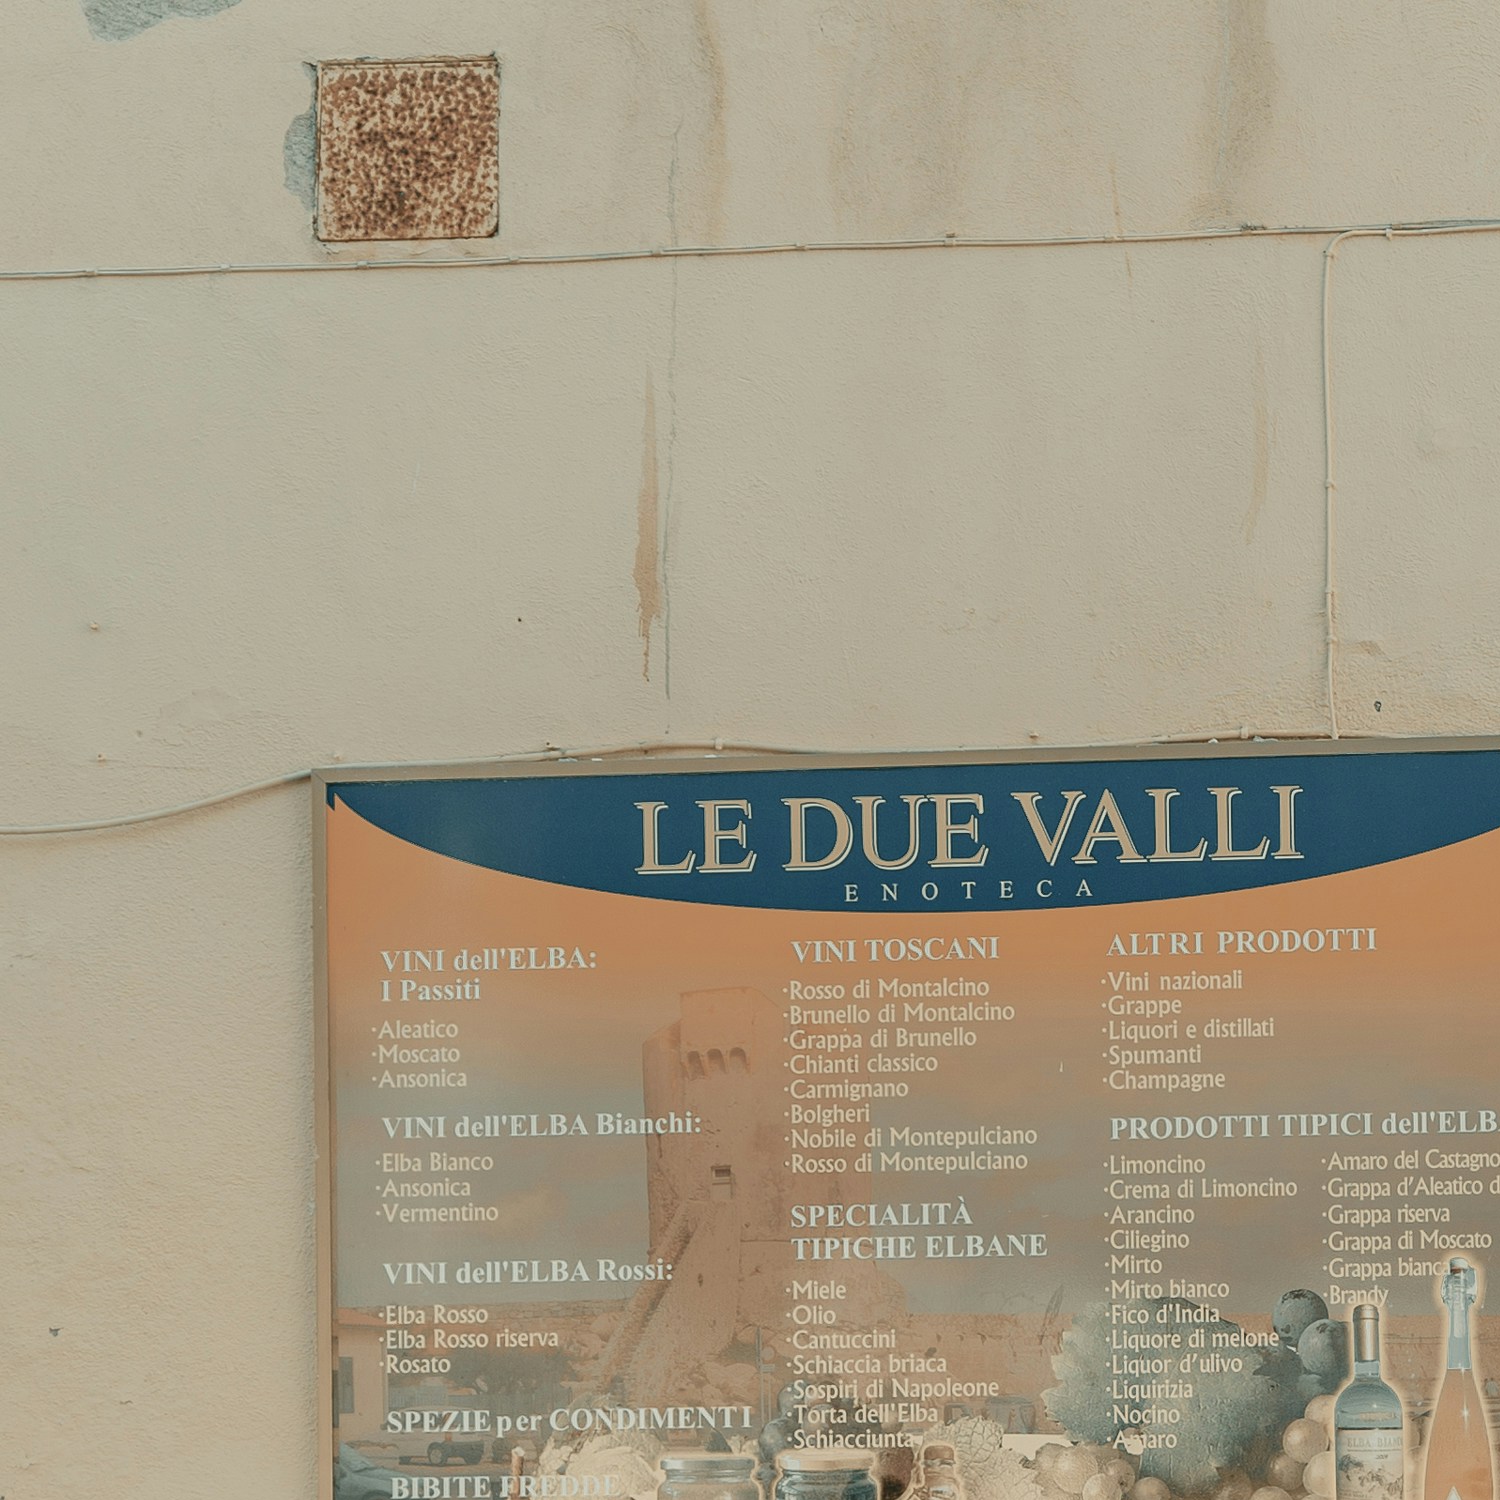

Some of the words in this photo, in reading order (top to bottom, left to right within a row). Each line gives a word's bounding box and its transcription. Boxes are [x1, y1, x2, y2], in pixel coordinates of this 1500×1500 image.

[635, 797, 757, 874] LE
[782, 793, 989, 870] DUE
[1012, 784, 1304, 866] VALLI
[845, 878, 1093, 902] ENOTECA
[791, 939, 856, 964] VINI
[864, 936, 1000, 962] TOSCANI
[1107, 931, 1204, 956] ALTRI
[1217, 927, 1377, 954] PRODOTTI
[381, 951, 444, 972] VINI
[454, 947, 597, 972] dell'ELBA:
[381, 980, 391, 1001] I
[401, 977, 481, 1001] Passiti
[790, 980, 844, 1000] Rosso
[853, 979, 870, 999] di
[878, 977, 989, 998] Montalcino
[1108, 971, 1149, 991] Vini
[1160, 970, 1242, 990] nazionali
[790, 1005, 870, 1025] Brunello
[878, 1004, 895, 1023] di
[904, 1002, 1015, 1023] Montalcino
[1108, 996, 1182, 1018] Grappe
[378, 1020, 458, 1039] Aleatico
[789, 1030, 862, 1052] Grappa
[870, 1029, 887, 1048] di
[896, 1027, 976, 1047] Brunello
[1109, 1020, 1177, 1043] Liquori
[1186, 1025, 1196, 1039] e
[1204, 1018, 1274, 1039] distillati
[378, 1044, 460, 1064] Moscato
[790, 1054, 859, 1074] Chianti
[867, 1053, 937, 1073] classico
[1109, 1045, 1201, 1068] Spumanti
[379, 1069, 467, 1089] Ansonica
[790, 1079, 908, 1101] Carmignano
[1109, 1070, 1225, 1092] Champagne
[382, 1117, 446, 1139] VINI
[454, 1113, 589, 1138] dell'ELBA
[595, 1111, 701, 1136] Bianchi:
[791, 1104, 869, 1126] Bolgheri
[1110, 1115, 1270, 1140] PRODOTTI
[1278, 1112, 1373, 1137] TIPICI
[791, 1129, 856, 1149] Nobile
[864, 1128, 881, 1147] di
[890, 1126, 1037, 1149] Montepulciano
[382, 1153, 422, 1172] Elba
[430, 1152, 494, 1172] Bianco
[792, 1154, 847, 1173] Rosso
[855, 1152, 872, 1172] di
[880, 1150, 1027, 1174] Montepulciano
[1110, 1154, 1205, 1175] Limoncino
[1328, 1152, 1387, 1171] Amaro
[1394, 1150, 1418, 1169] del
[382, 1178, 471, 1198] Ansonica
[1110, 1180, 1169, 1200] Crema
[1177, 1179, 1194, 1198] di
[1201, 1177, 1297, 1198] Limoncino
[1328, 1178, 1390, 1200] Grappa
[383, 1203, 498, 1222] Vermentino
[791, 1196, 973, 1229] SPECIALITÀ
[1110, 1205, 1195, 1225] Arancino
[1328, 1205, 1391, 1227] Grappa
[1398, 1204, 1450, 1223] riserva
[791, 1236, 916, 1260] TIPICHE
[925, 1234, 1048, 1259] ELBANE
[1110, 1229, 1189, 1252] Ciliegino
[1328, 1232, 1391, 1254] Grappa
[1398, 1230, 1413, 1250] di
[1420, 1229, 1492, 1249] Moscato
[383, 1262, 447, 1285] VINI
[456, 1260, 590, 1284] dell'ELBA
[597, 1258, 673, 1282] Rossi:
[1111, 1254, 1162, 1274] Mirto
[1328, 1258, 1391, 1281] Grappa
[792, 1280, 846, 1300] Miele
[1111, 1279, 1162, 1299] Mirto
[1170, 1279, 1229, 1299] bianco
[1330, 1285, 1388, 1306] Brandy
[386, 1305, 426, 1324] Elba
[433, 1305, 488, 1324] Rosso
[792, 1305, 836, 1325] Olio
[1111, 1304, 1149, 1324] Fico
[1156, 1303, 1219, 1324] d'India
[386, 1330, 426, 1350] Elba
[433, 1329, 488, 1349] Rosso
[496, 1328, 558, 1347] riserva
[792, 1329, 895, 1349] Cantuccini
[1112, 1329, 1180, 1352] Liquore
[1189, 1329, 1205, 1349] di
[1212, 1328, 1279, 1348] melone
[386, 1355, 451, 1374] Rosato
[793, 1354, 881, 1374] Schiaccia
[889, 1353, 946, 1373] briaca
[1113, 1354, 1172, 1376] Liquor
[793, 1379, 858, 1401] Sospiri
[866, 1379, 883, 1398] di
[892, 1378, 999, 1400] Napoleone
[1113, 1379, 1192, 1401] Liquirizia
[386, 1410, 491, 1434] SPEZIE
[496, 1414, 542, 1438] per
[549, 1405, 752, 1432] CONDIMENTI
[794, 1404, 847, 1424] Torta
[855, 1403, 938, 1422] dell'Elba
[1113, 1404, 1180, 1423] Nocino
[793, 1428, 914, 1449] Schiacciunta
[391, 1475, 491, 1500] BIBITE
[499, 1474, 621, 1498] FREDDE
